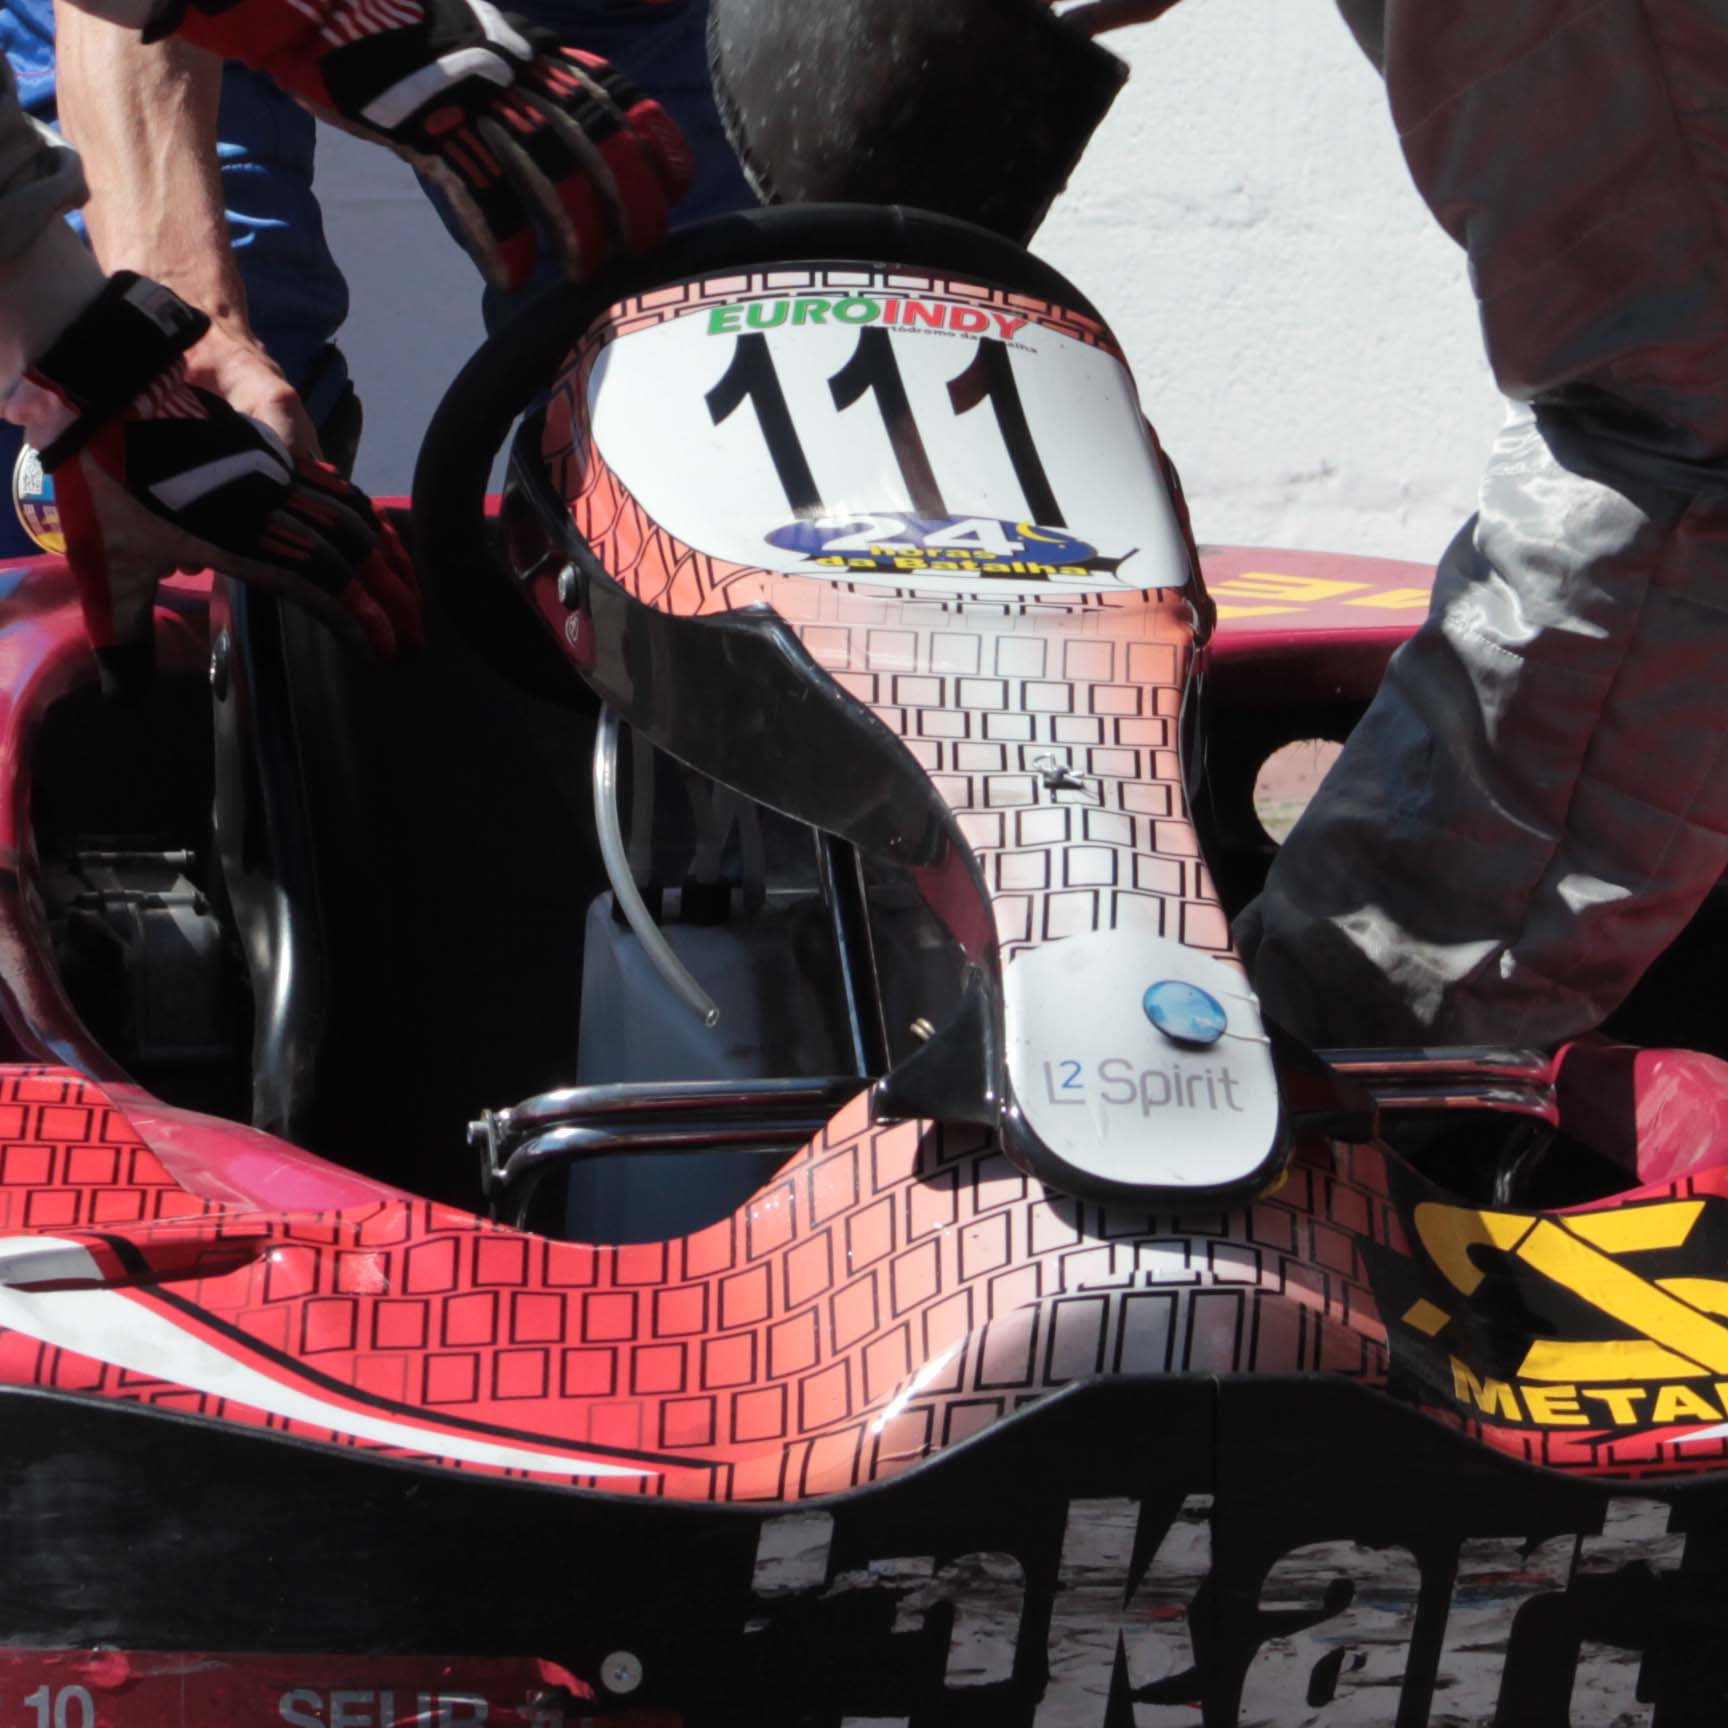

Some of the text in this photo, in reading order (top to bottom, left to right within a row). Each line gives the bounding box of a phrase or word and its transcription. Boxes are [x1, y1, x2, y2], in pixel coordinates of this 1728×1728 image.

[707, 296, 1037, 341] EUROINDY
[704, 326, 1068, 529] 111
[817, 514, 1029, 557] 24
[868, 543, 998, 561] horas
[814, 555, 1093, 577] da Batalha
[1097, 1056, 1245, 1116] Spirit
[25, 1685, 95, 1728] 10
